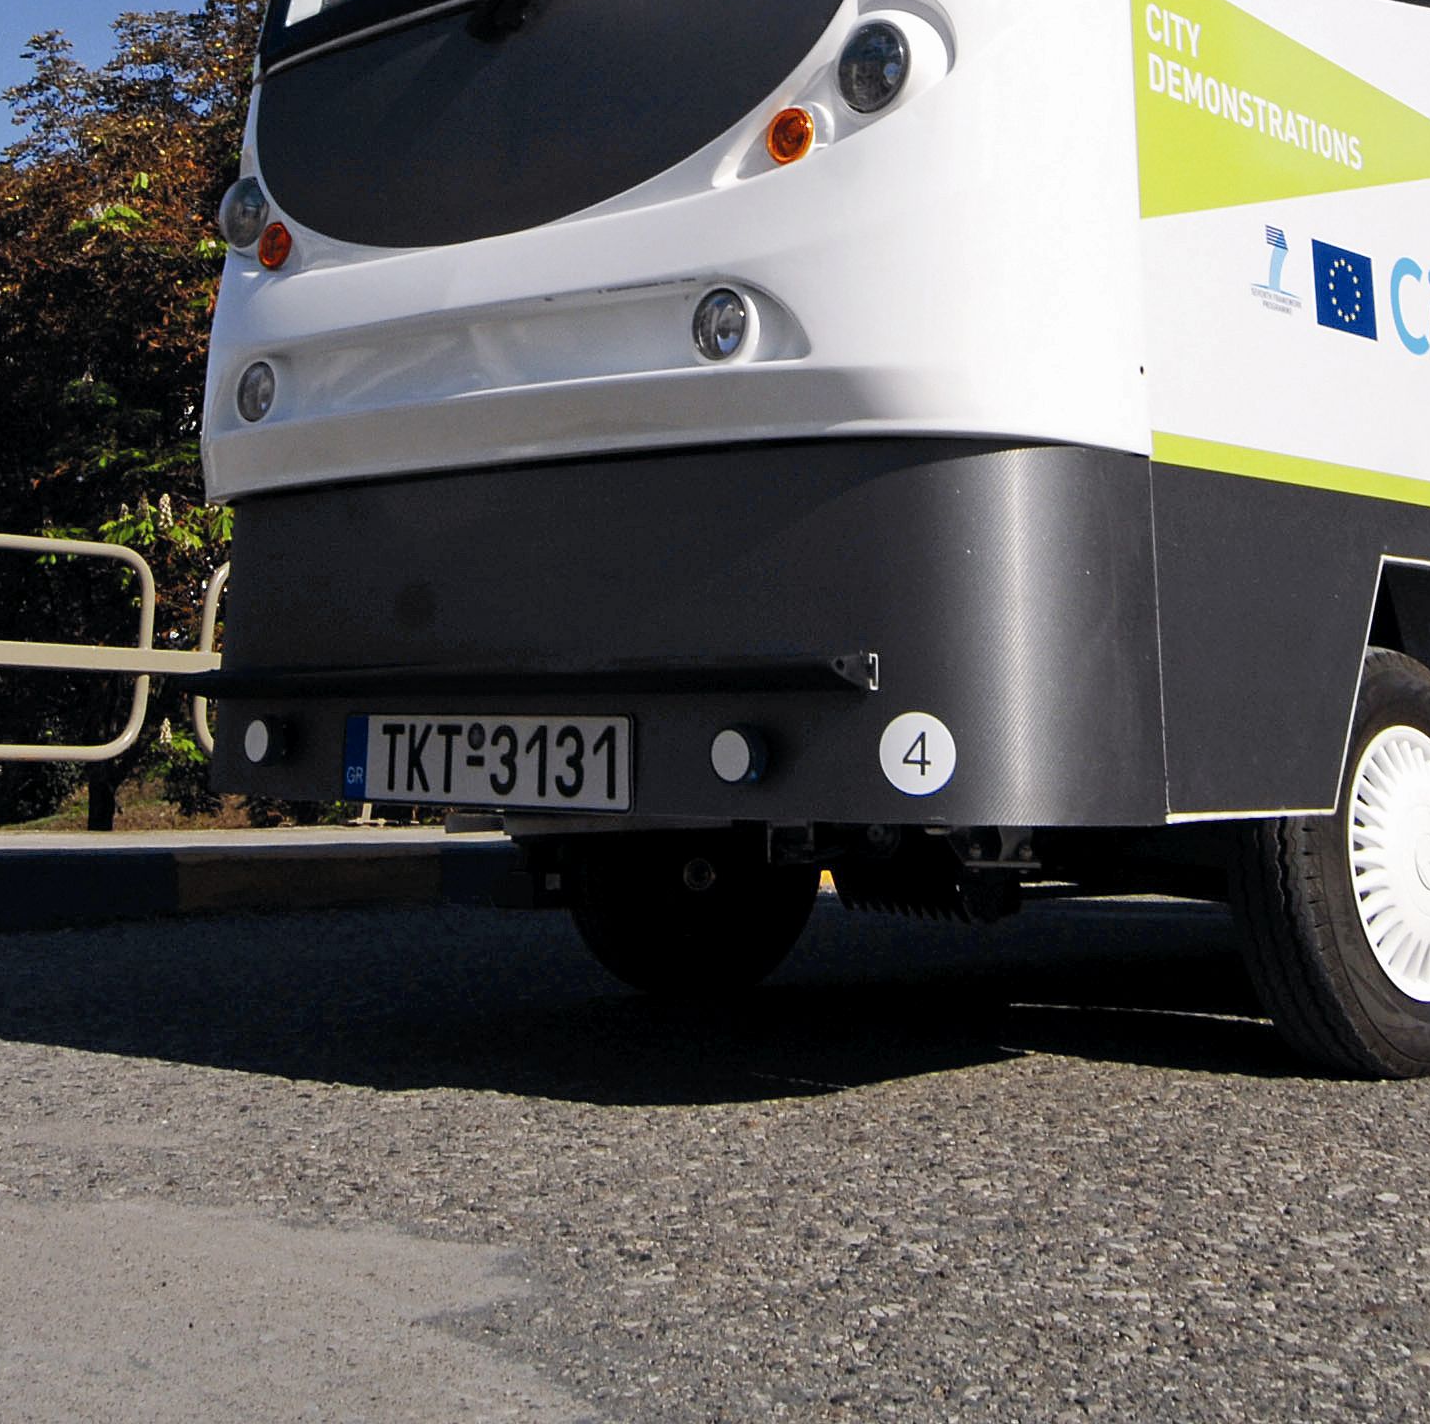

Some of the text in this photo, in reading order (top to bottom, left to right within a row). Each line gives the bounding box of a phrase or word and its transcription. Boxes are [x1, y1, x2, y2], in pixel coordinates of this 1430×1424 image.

[1145, 2, 1201, 57] CITY
[1147, 53, 1364, 171] DEMONSTRATIONS
[346, 765, 364, 786] GR
[902, 729, 932, 777] 4
